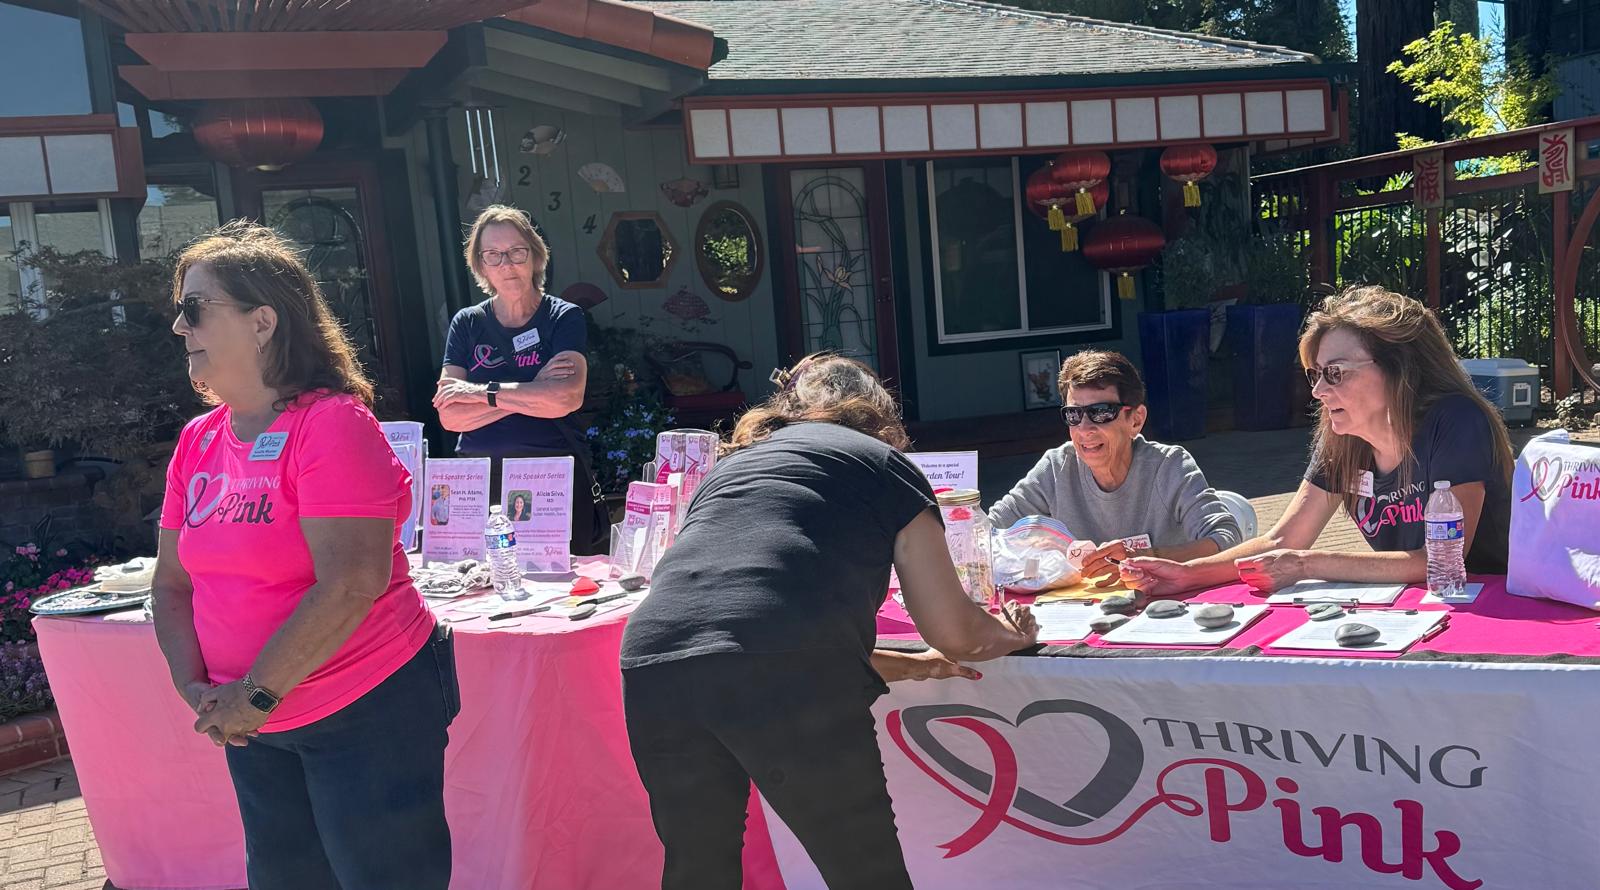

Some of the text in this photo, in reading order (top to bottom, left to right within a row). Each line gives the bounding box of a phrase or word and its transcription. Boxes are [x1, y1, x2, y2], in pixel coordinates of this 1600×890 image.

[518, 165, 531, 187] 2
[547, 192, 562, 212] 3
[582, 214, 597, 235] 4
[512, 351, 541, 368] ink
[466, 473, 484, 481] Series
[509, 472, 565, 482] Pink Speaker Series
[926, 470, 965, 480] rden Tour!
[1564, 461, 1600, 473] THRIVIN
[218, 492, 275, 524] Pink
[1381, 496, 1425, 526] Pink
[1142, 717, 1488, 789] THRIVING
[1156, 757, 1484, 890] Pink
